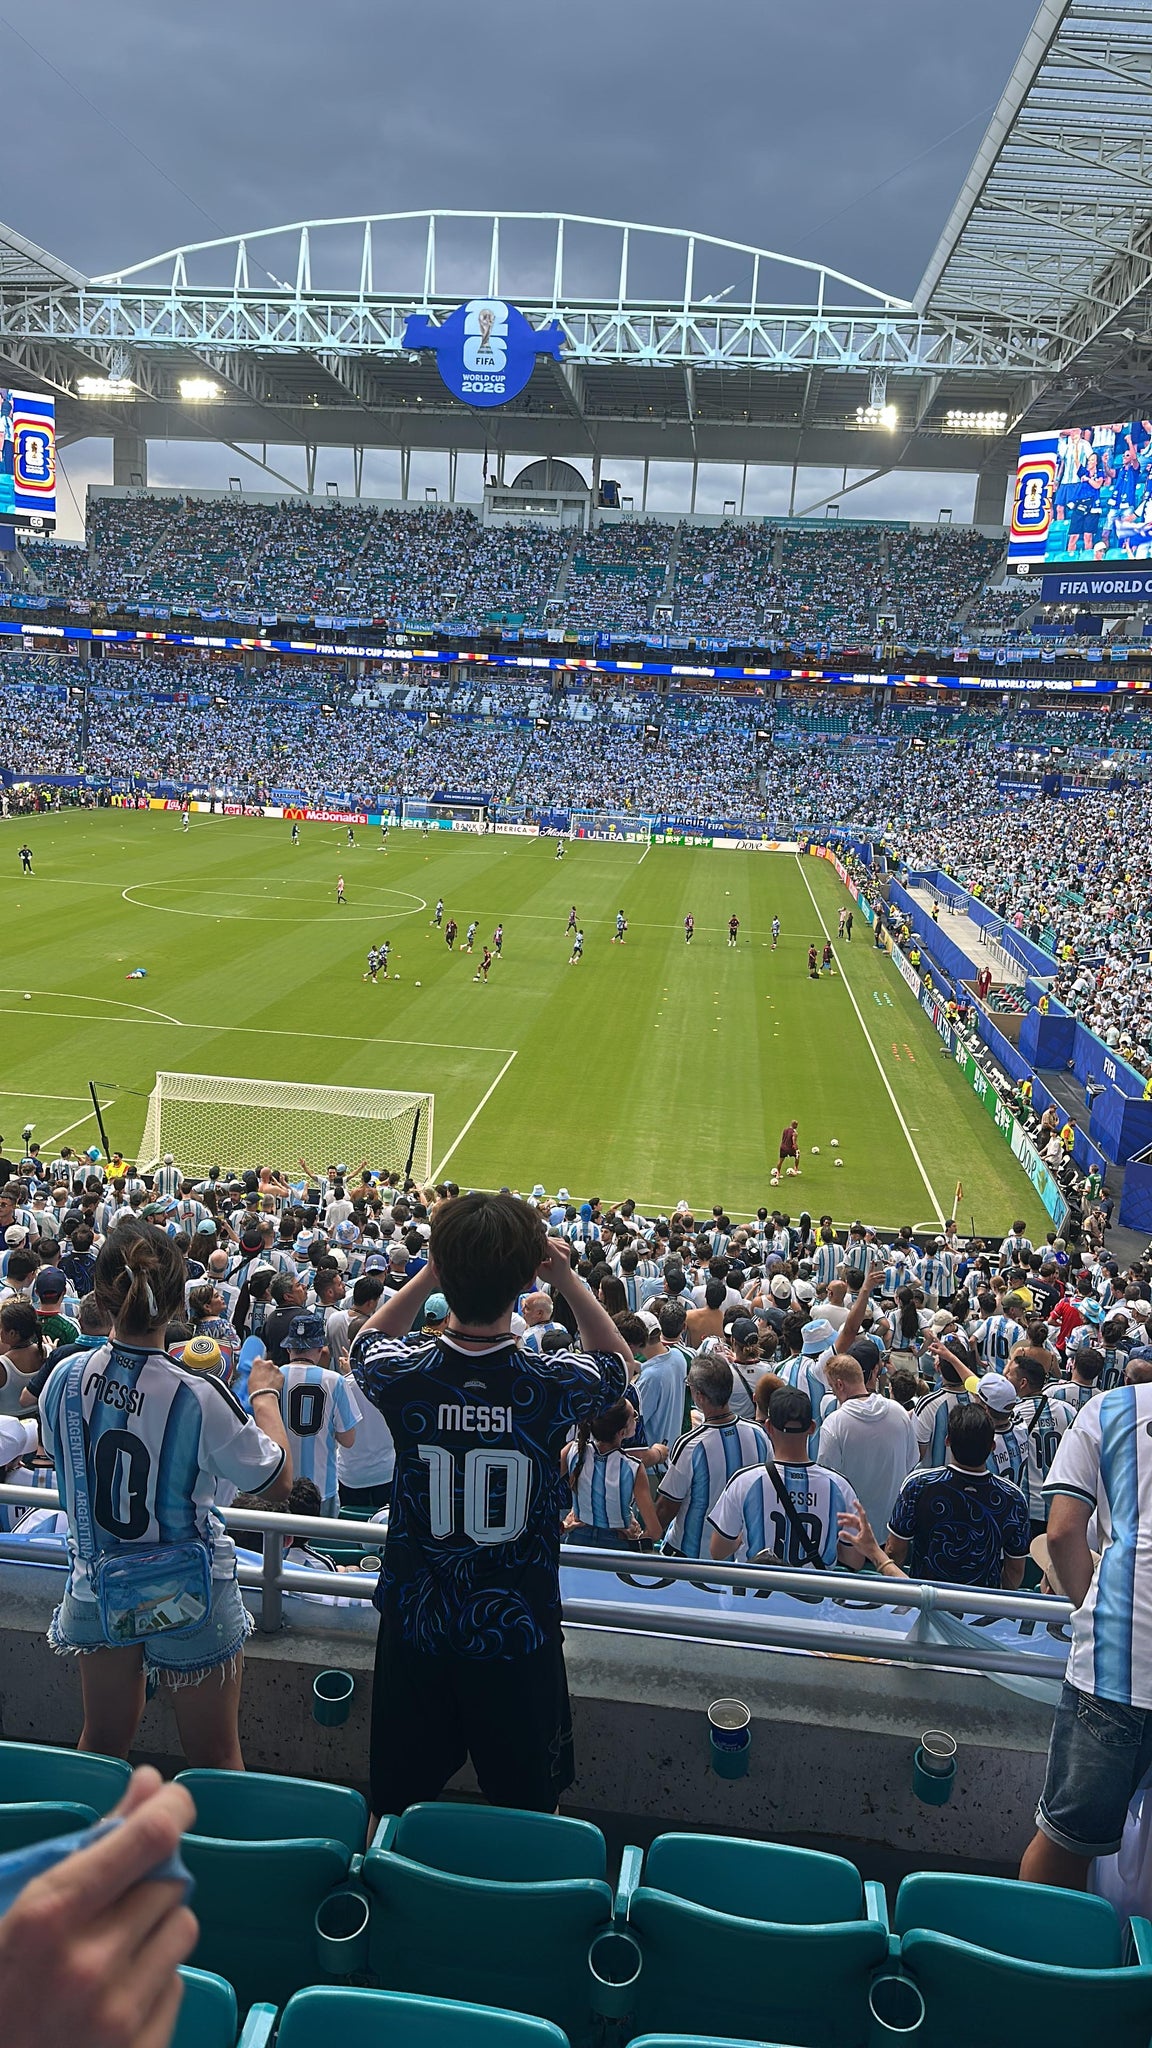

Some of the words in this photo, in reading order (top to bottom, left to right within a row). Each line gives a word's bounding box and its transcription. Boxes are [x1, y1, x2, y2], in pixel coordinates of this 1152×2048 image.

[475, 357, 495, 366] FIFA
[462, 373, 490, 382] WORLD
[490, 374, 506, 383] CUP
[461, 381, 505, 394] 2026
[31, 518, 42, 526] CC
[1059, 581, 1089, 594] FIFA
[1091, 579, 1143, 593] WORLD
[316, 644, 334, 654] FIFA
[334, 645, 365, 656] WORLD
[365, 647, 383, 657] CUP
[980, 678, 997, 689] FIFA
[997, 679, 1025, 690] WORLD
[1026, 680, 1043, 690] CUP
[305, 811, 367, 825] McDonald's
[455, 822, 478, 832] BANK
[707, 823, 724, 831] FIFA
[587, 829, 624, 841] ULTRA
[735, 840, 763, 851] Dove
[1103, 1056, 1117, 1082] FIFA
[924, 1270, 934, 1288] 9
[991, 1333, 1009, 1359] 10
[83, 1372, 145, 1418] MESSI
[437, 1403, 513, 1434] MESSI
[66, 1409, 86, 1479] ARGENTINA
[417, 1443, 533, 1547] 10
[776, 1490, 817, 1508] ESSI
[769, 1510, 823, 1568] 10
